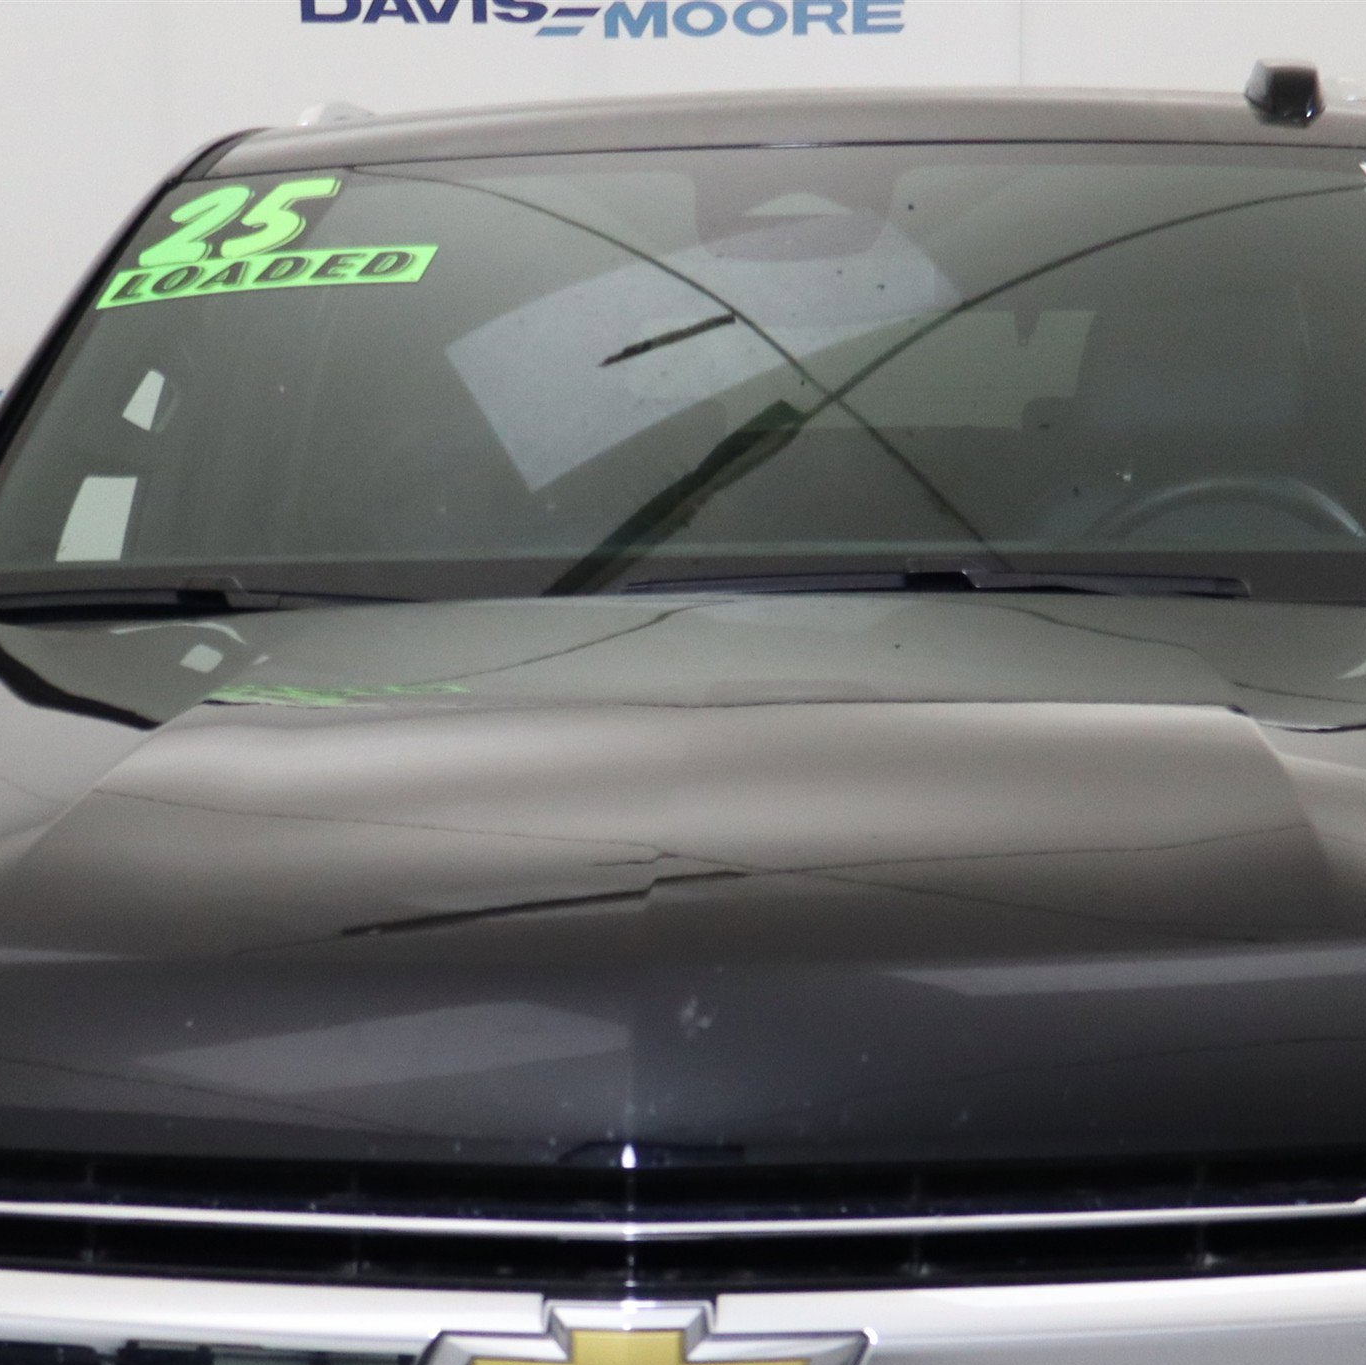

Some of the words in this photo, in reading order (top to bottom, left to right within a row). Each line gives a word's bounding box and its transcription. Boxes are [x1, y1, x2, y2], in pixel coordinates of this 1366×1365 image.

[301, 0, 547, 24] DAVIS
[601, 0, 905, 38] MOORE
[138, 178, 342, 267] 25
[110, 250, 417, 301] LOADED
